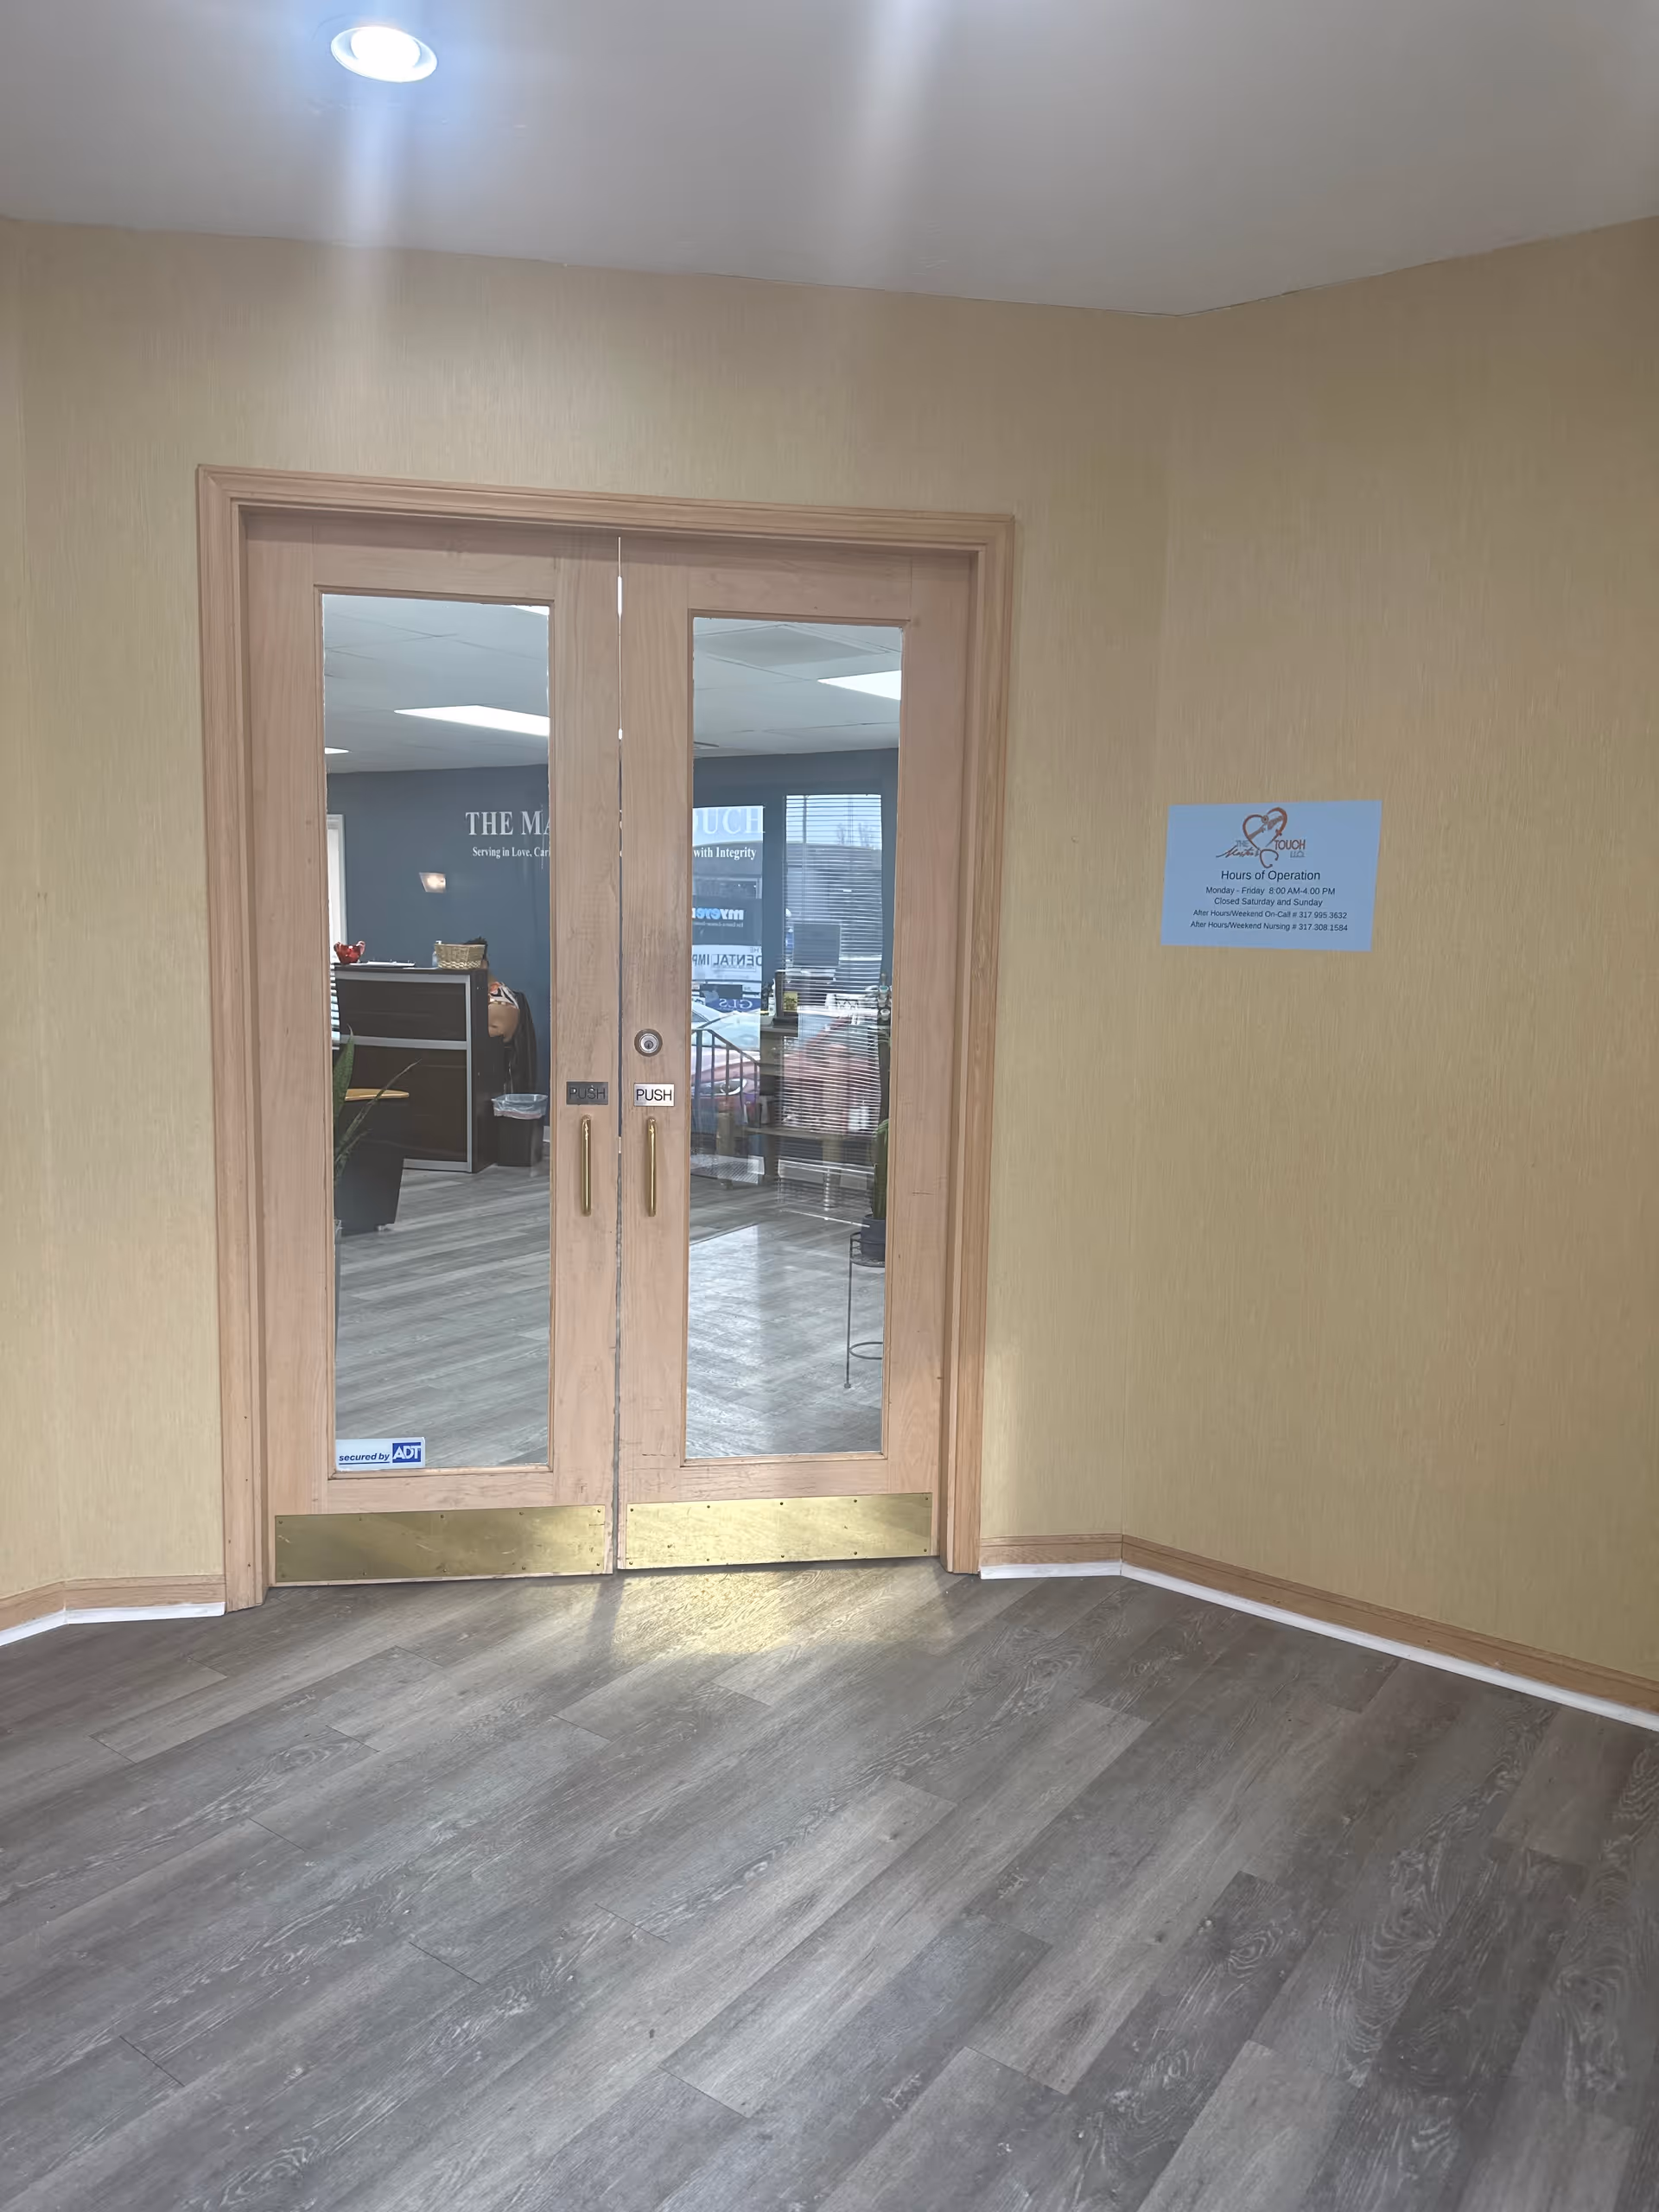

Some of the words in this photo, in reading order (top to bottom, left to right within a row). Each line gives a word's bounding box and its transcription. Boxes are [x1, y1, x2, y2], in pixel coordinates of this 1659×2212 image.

[465, 811, 513, 835] THE
[1274, 839, 1306, 850] TOUCH
[473, 846, 500, 859] Serving
[502, 847, 510, 856] in
[512, 847, 532, 857] Love,
[693, 847, 713, 858] with
[715, 847, 756, 861] Integrity
[1221, 870, 1251, 880] Hours
[1255, 870, 1266, 880] of
[1268, 870, 1320, 882] Operation
[1205, 887, 1236, 895] Monday
[1242, 887, 1265, 895] Friday
[1242, 898, 1274, 906] Saturday
[1293, 898, 1323, 907] Sunday
[1263, 923, 1290, 931] Nursing
[569, 1086, 606, 1099] PUSH
[636, 1089, 672, 1101] PUSH
[339, 1452, 378, 1461] secured
[378, 1452, 391, 1461] by
[392, 1445, 421, 1459] ADT
